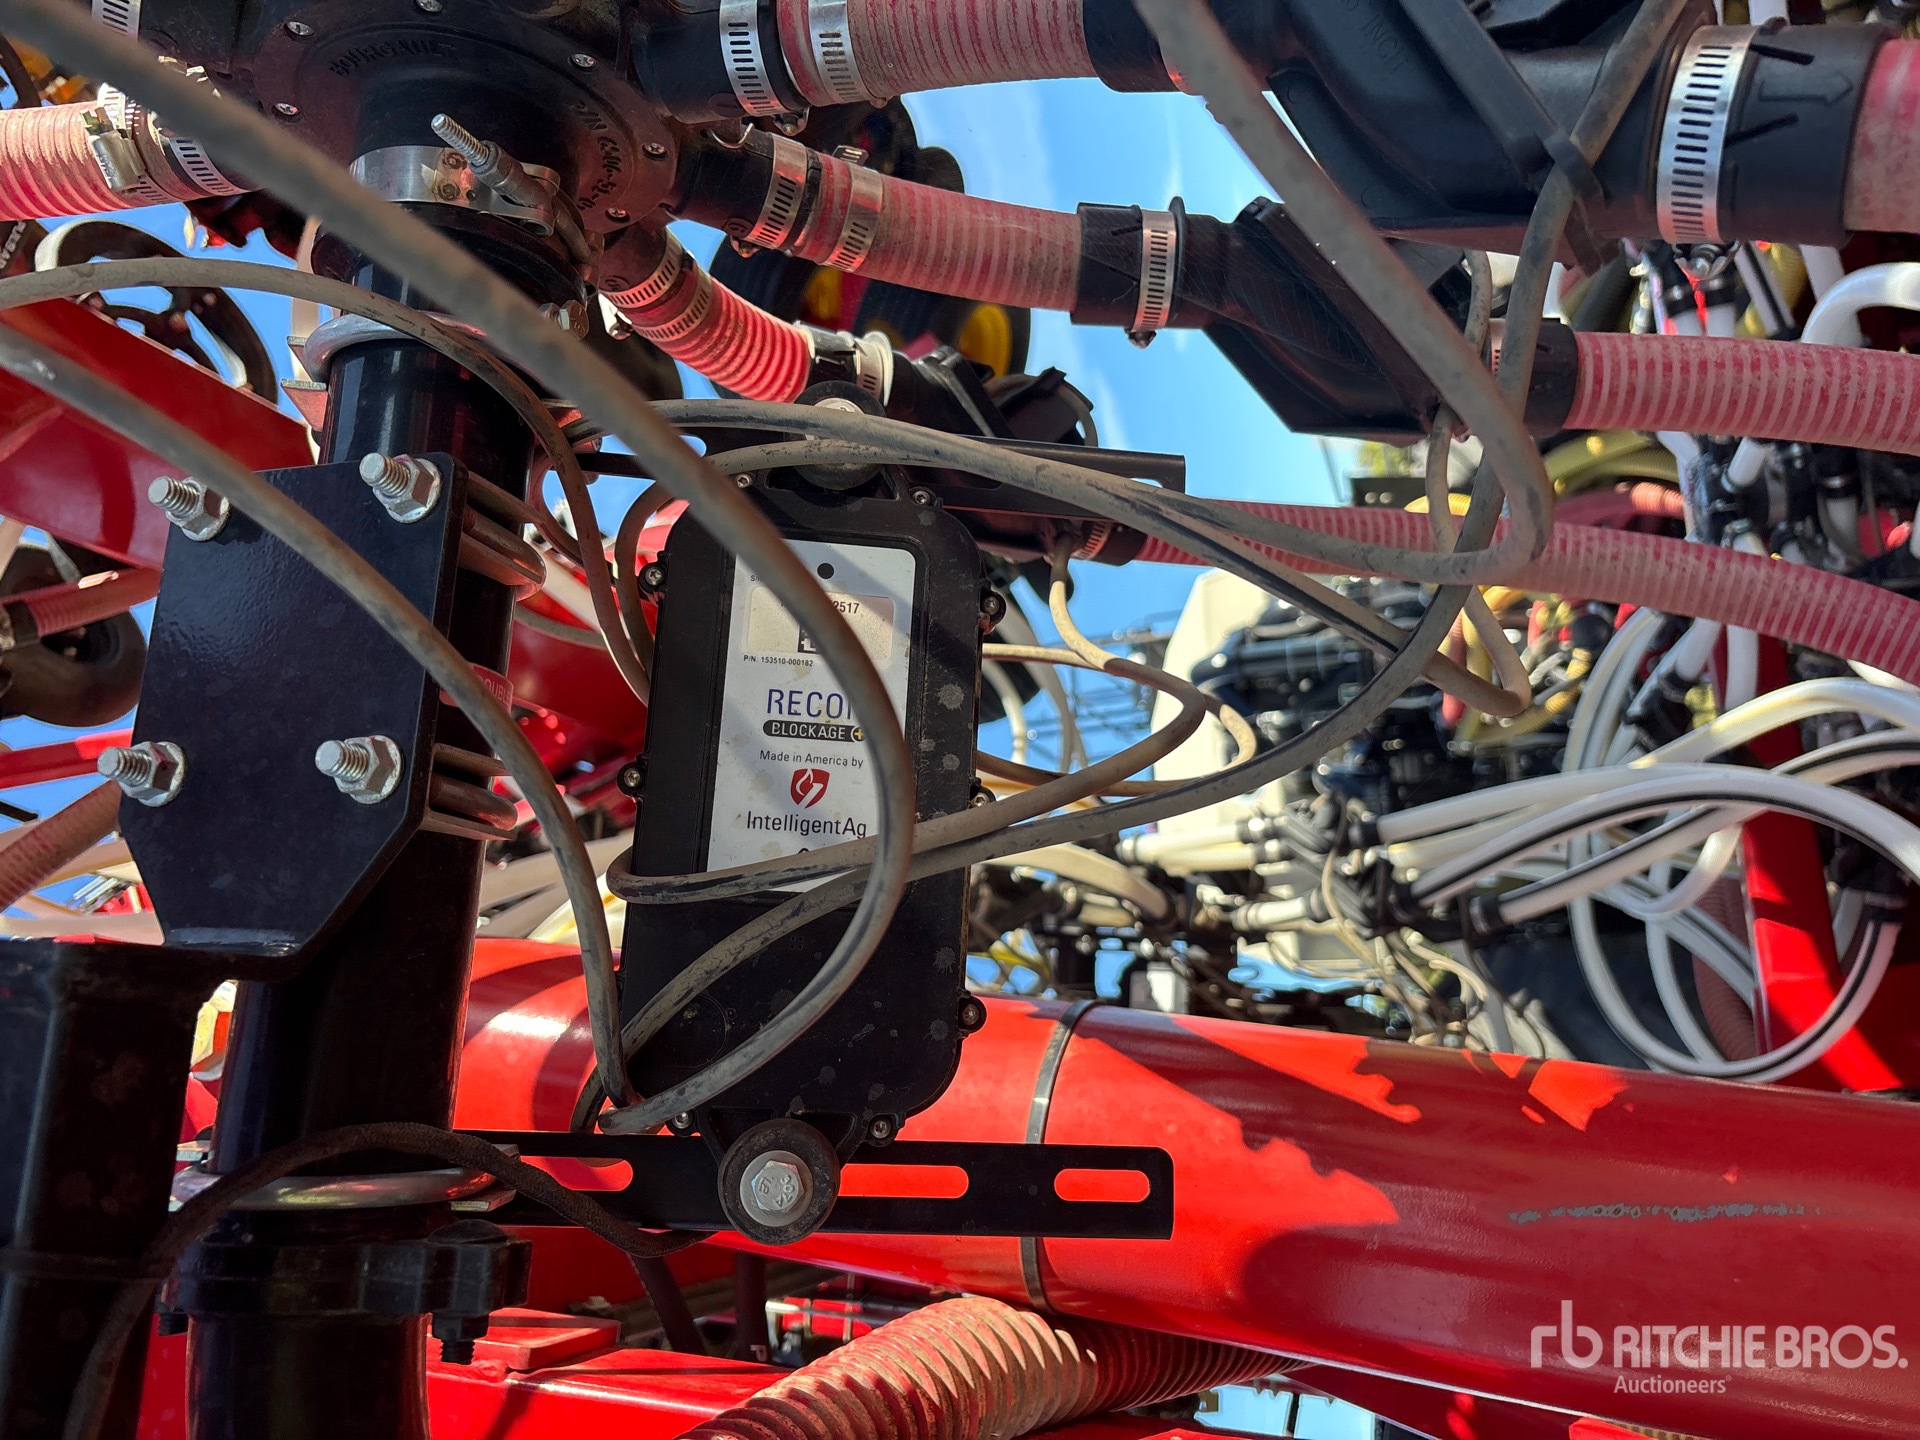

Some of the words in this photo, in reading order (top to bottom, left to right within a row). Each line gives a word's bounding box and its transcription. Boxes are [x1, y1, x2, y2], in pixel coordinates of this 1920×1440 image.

[761, 656, 814, 667] 153510-000182
[767, 688, 851, 720] RECO
[759, 749, 790, 762] Made
[793, 752, 802, 762] in
[805, 753, 848, 767] America
[851, 757, 864, 769] by
[746, 810, 867, 839] IntelligentAg
